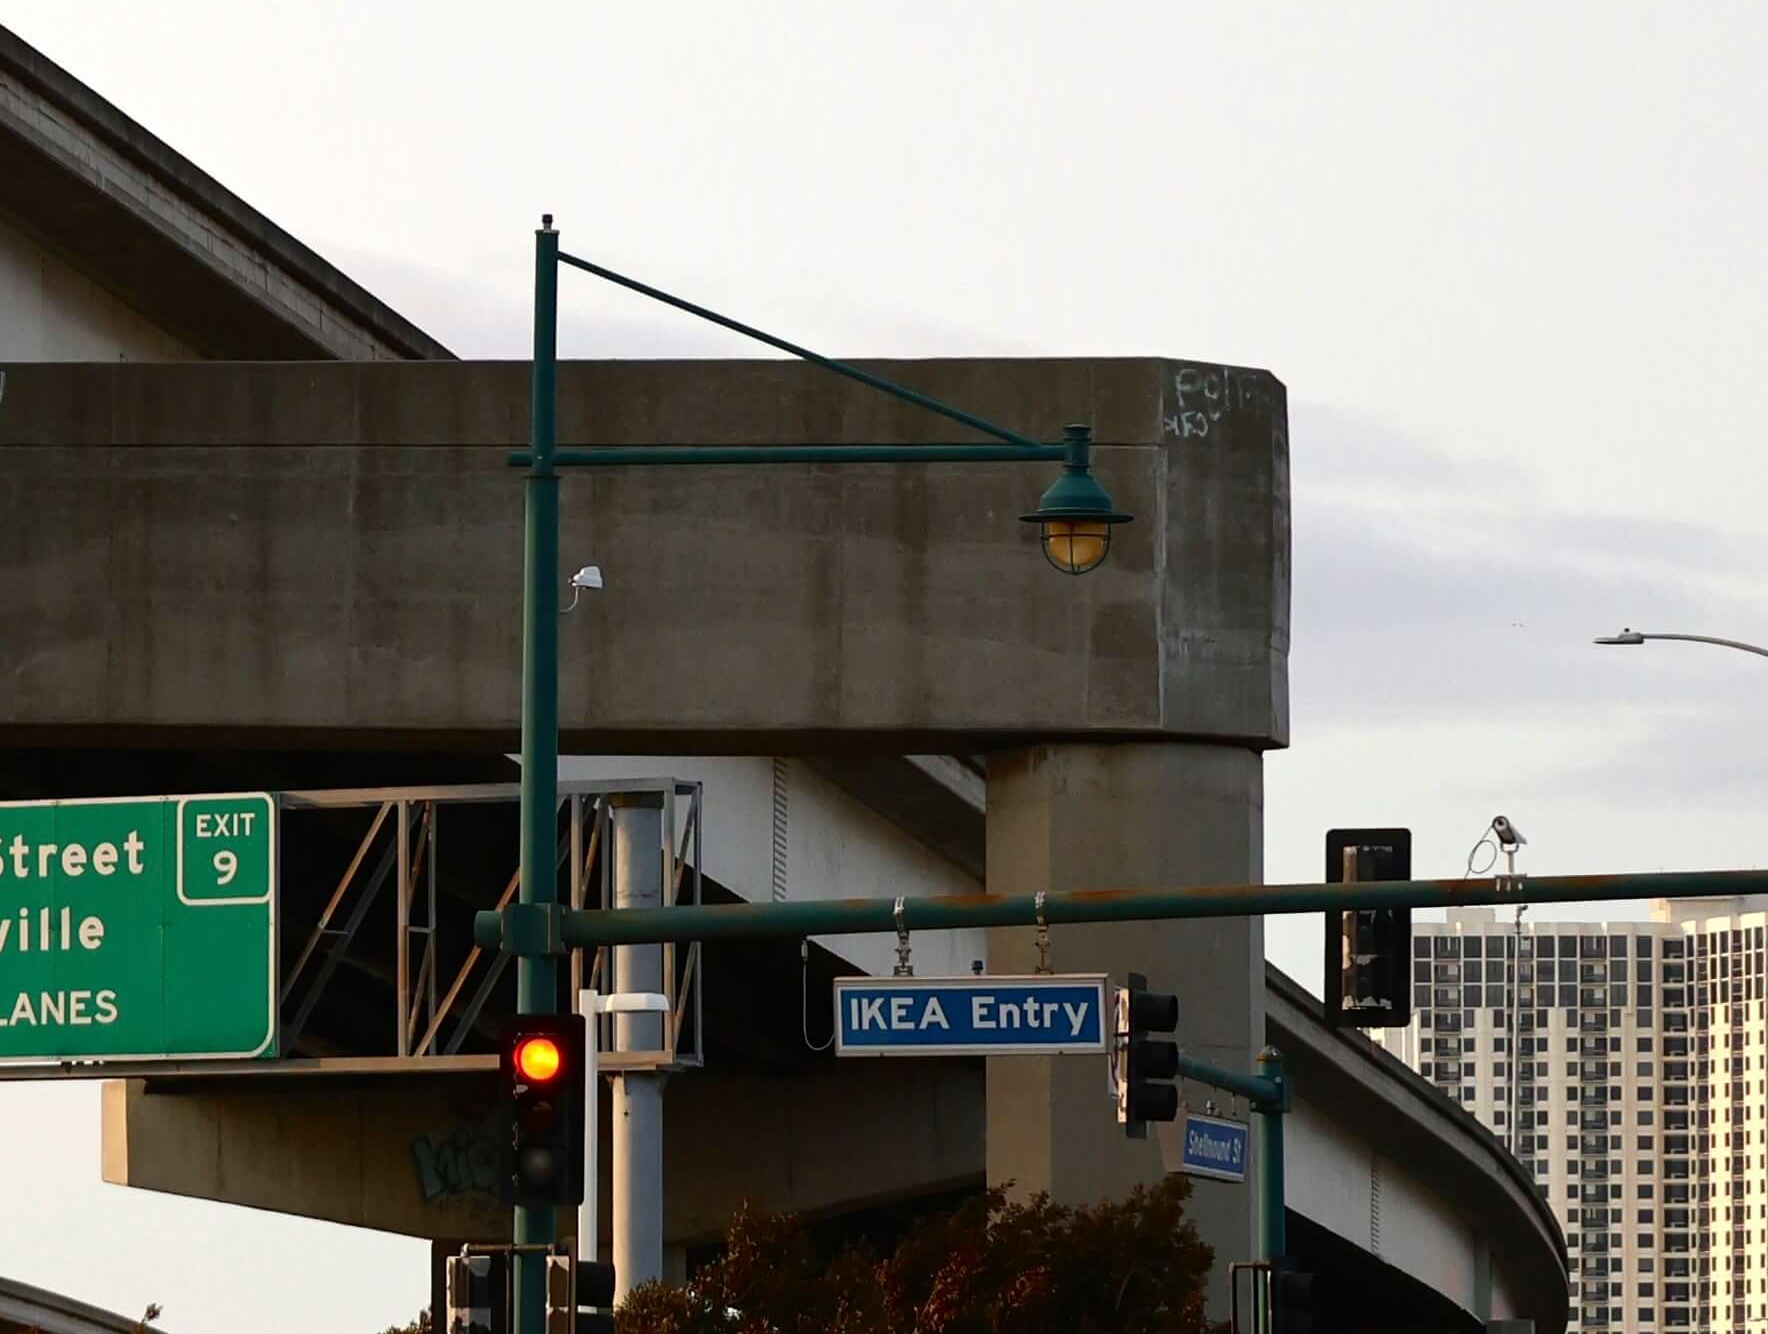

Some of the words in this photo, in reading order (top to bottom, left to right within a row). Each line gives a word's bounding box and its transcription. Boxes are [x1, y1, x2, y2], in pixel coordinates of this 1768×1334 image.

[196, 813, 255, 837] EXIT
[213, 850, 239, 885] 9
[849, 996, 951, 1031] IKEA
[971, 995, 1089, 1036] Entry
